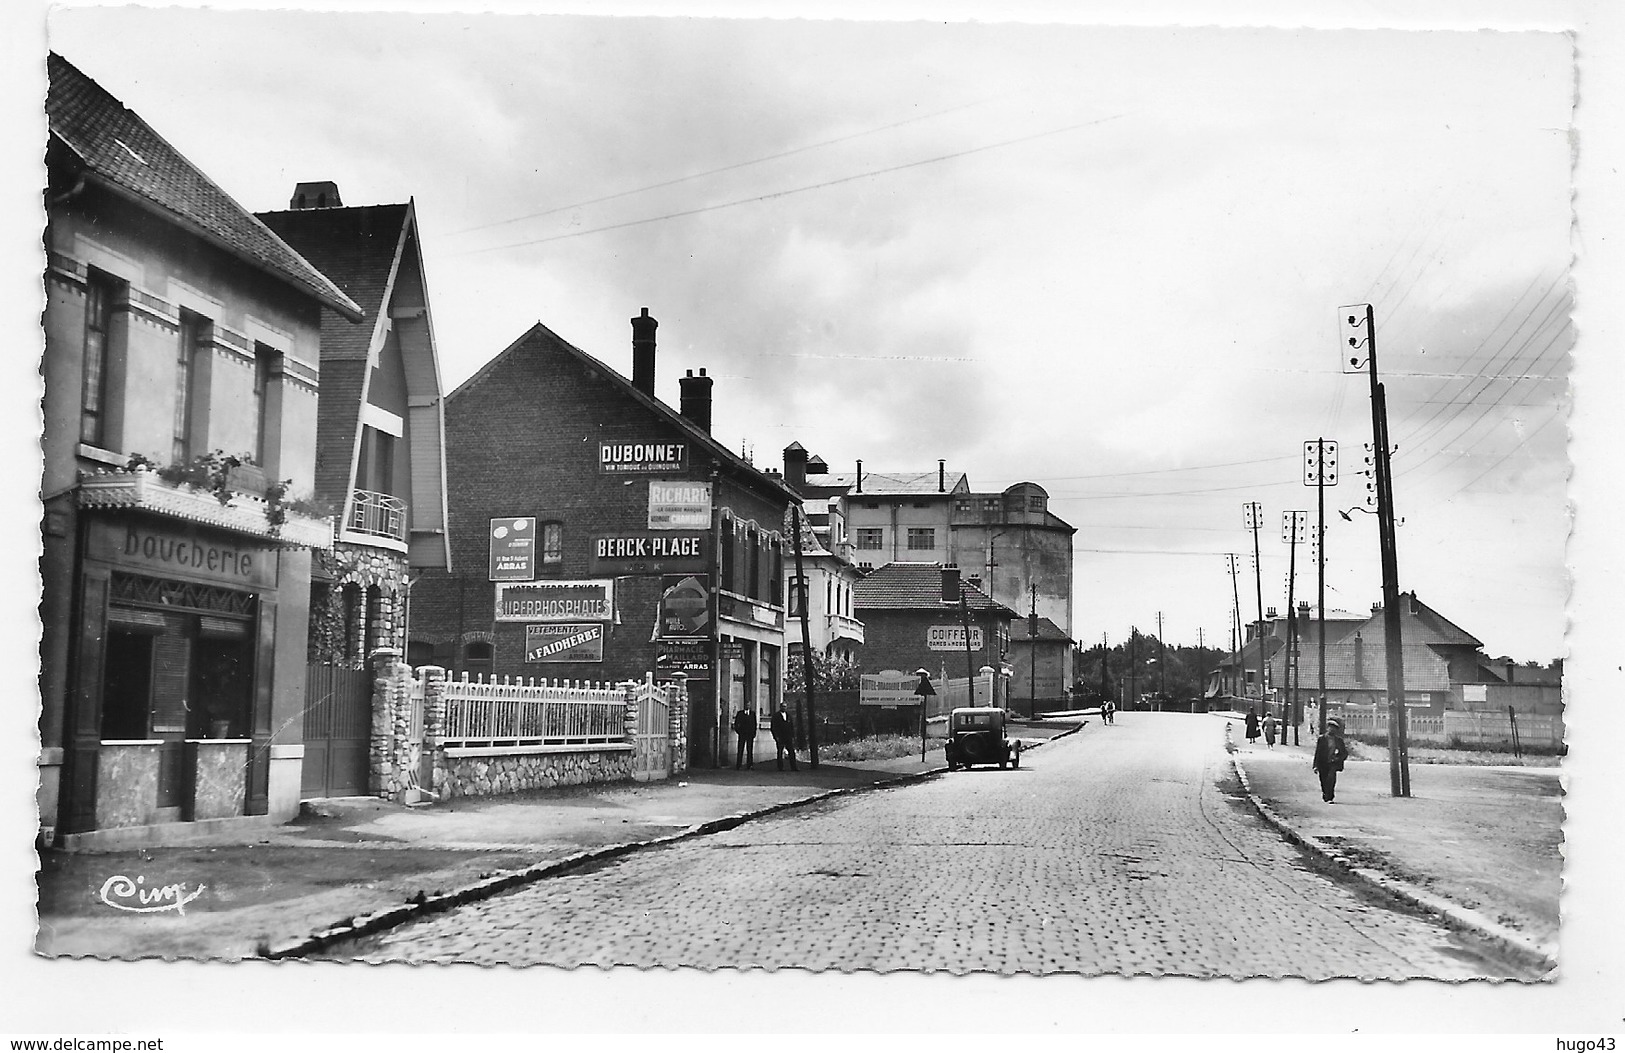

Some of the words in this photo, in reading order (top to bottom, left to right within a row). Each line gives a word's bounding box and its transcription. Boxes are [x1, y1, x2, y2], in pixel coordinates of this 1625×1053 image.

[602, 444, 684, 462] DUBONNET
[652, 486, 709, 502] RICHARD
[124, 525, 252, 576] boucherie
[496, 562, 527, 570] ARRAS
[496, 599, 612, 617] SUPERPHOSPHATES
[535, 627, 600, 659] FAIDHERBE
[658, 645, 704, 653] PHARMACIE
